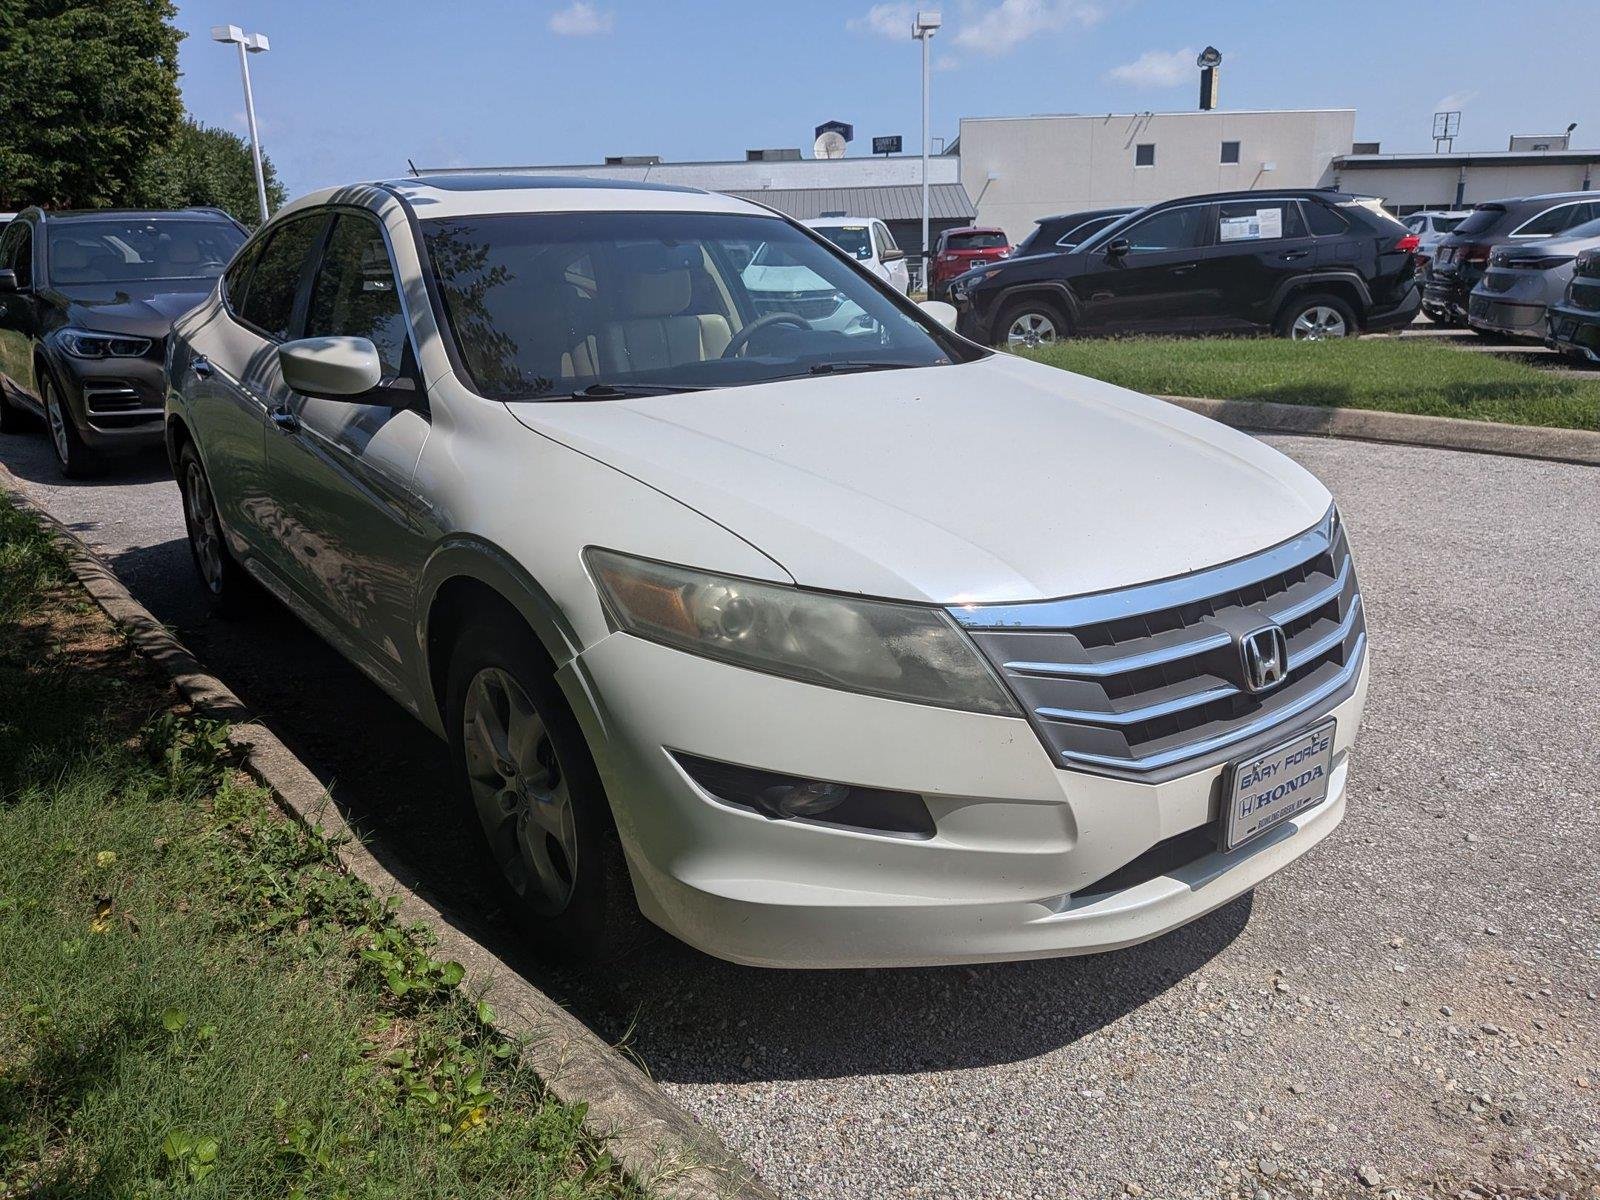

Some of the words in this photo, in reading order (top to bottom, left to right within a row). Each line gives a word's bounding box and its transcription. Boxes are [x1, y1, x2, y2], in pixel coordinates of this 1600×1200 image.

[1241, 761, 1281, 790] GARY
[1285, 737, 1329, 770] FORCE
[1256, 765, 1324, 809] HONDA
